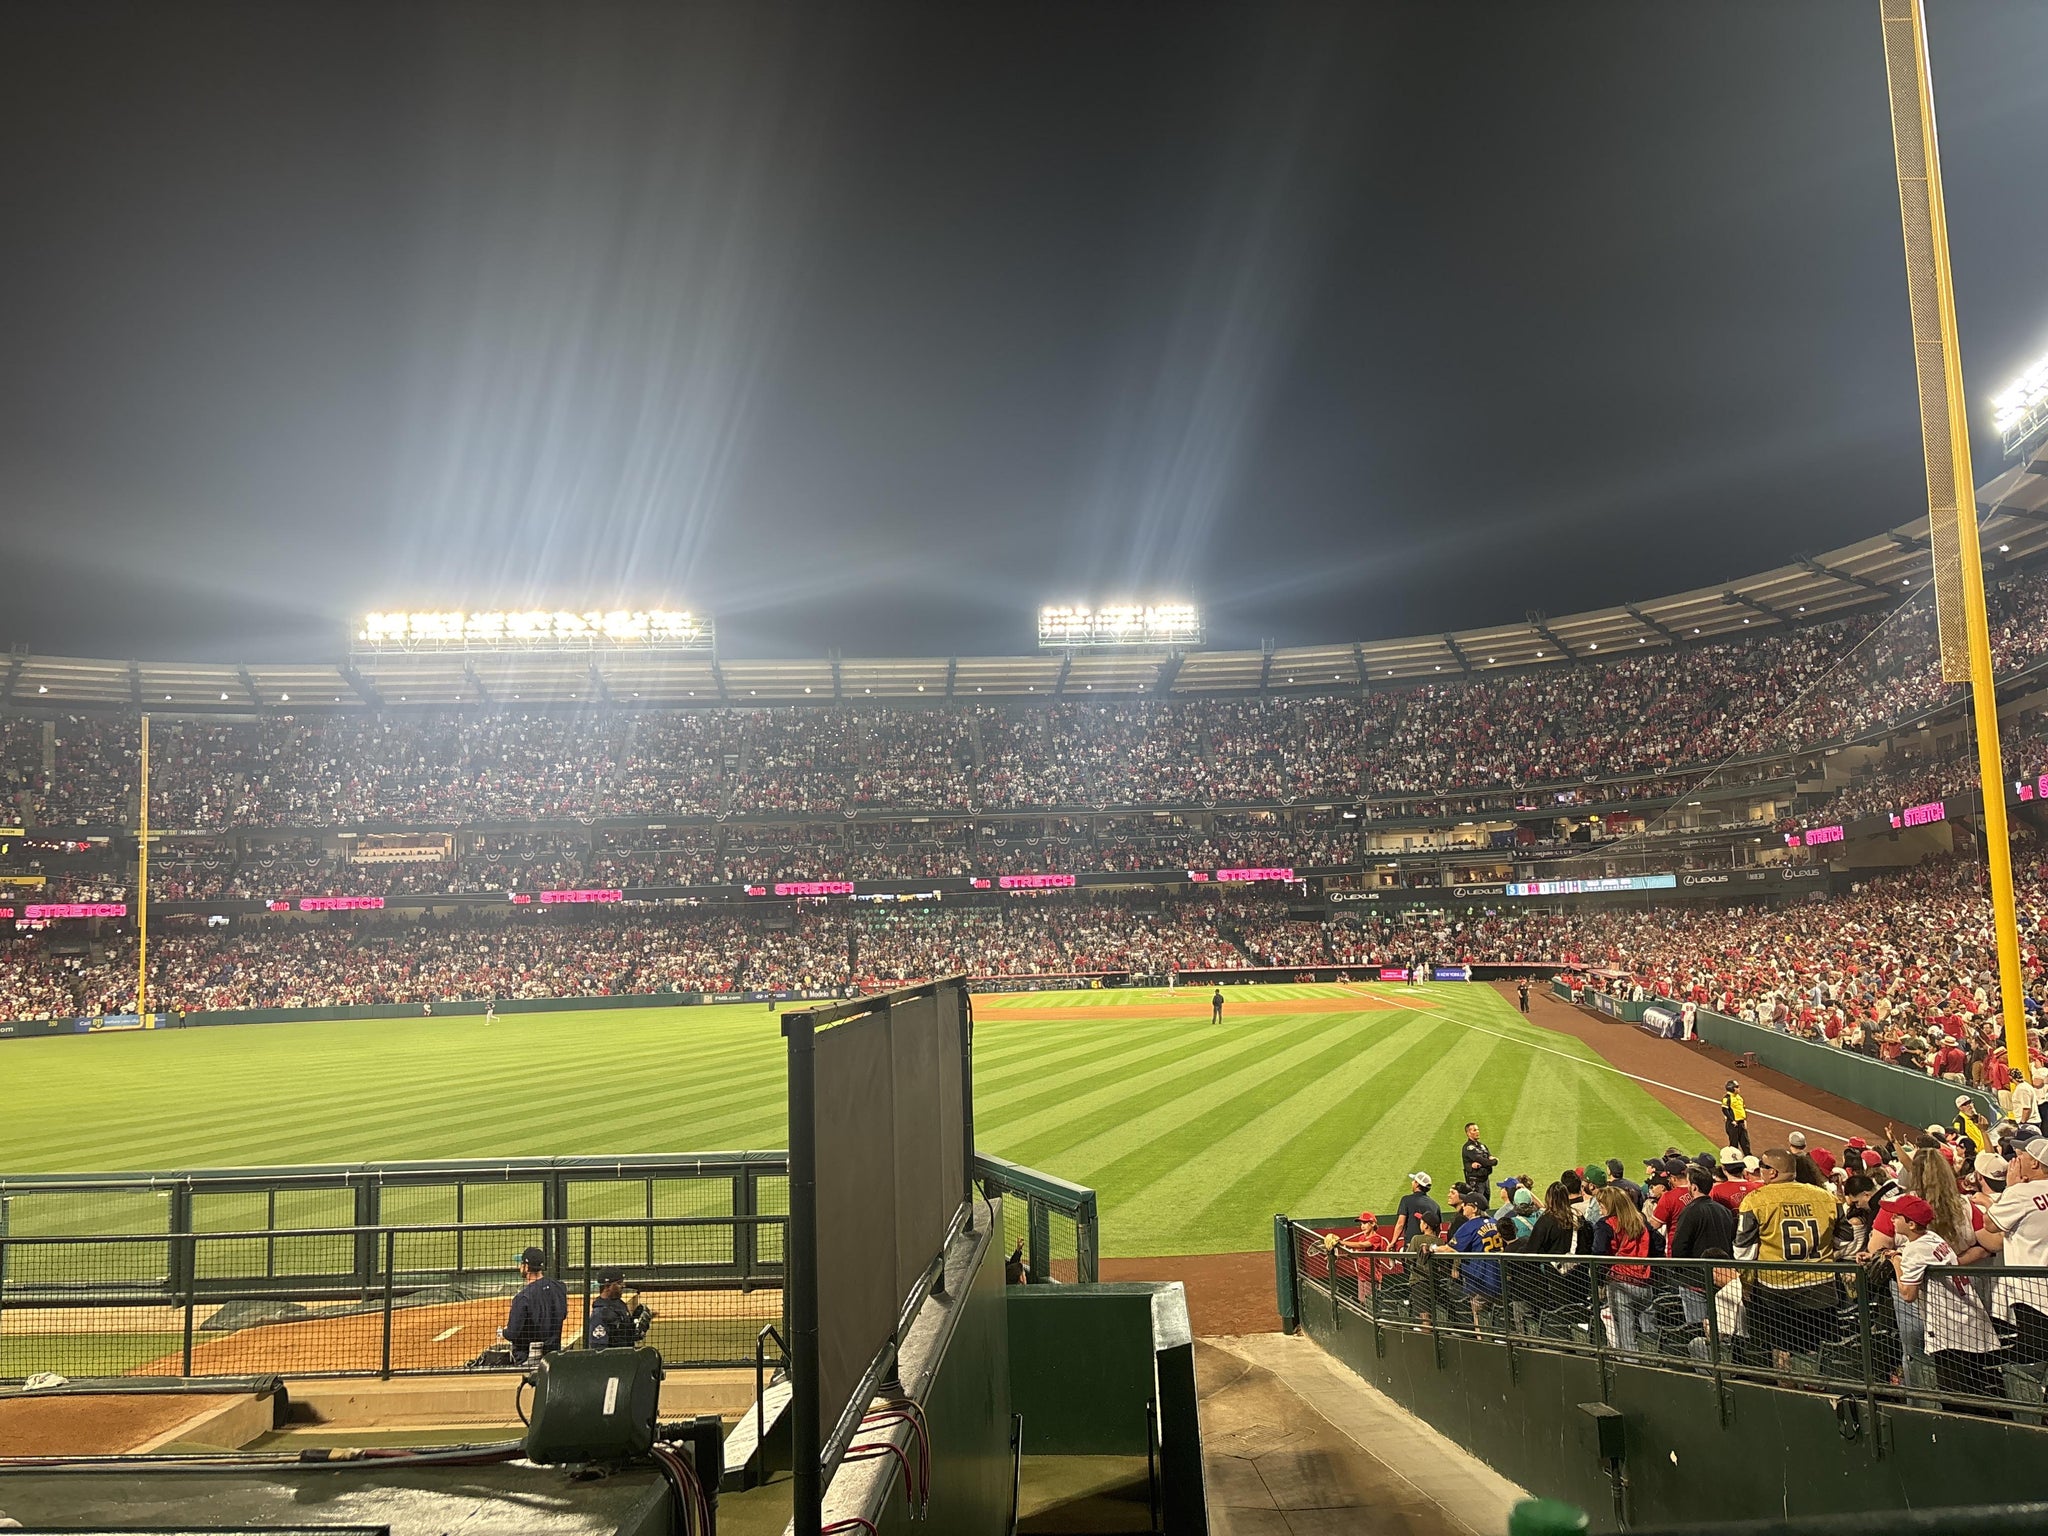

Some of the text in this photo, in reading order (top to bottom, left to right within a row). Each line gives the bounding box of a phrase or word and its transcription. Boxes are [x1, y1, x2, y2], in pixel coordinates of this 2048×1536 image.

[1904, 802, 1945, 827] STRETCH
[1806, 826, 1844, 846] STRETCH
[1217, 869, 1294, 881] STRETCH
[1794, 869, 1819, 877] LEXUS
[1000, 875, 1075, 887] STRETCH
[775, 882, 854, 895] STRETCH
[540, 890, 622, 903] STRETCH
[25, 904, 126, 917] STRETCH
[300, 897, 384, 911] STRETCH
[809, 990, 829, 998] Modelo
[1782, 1203, 1814, 1217] STONE
[1780, 1218, 1822, 1262] 61
